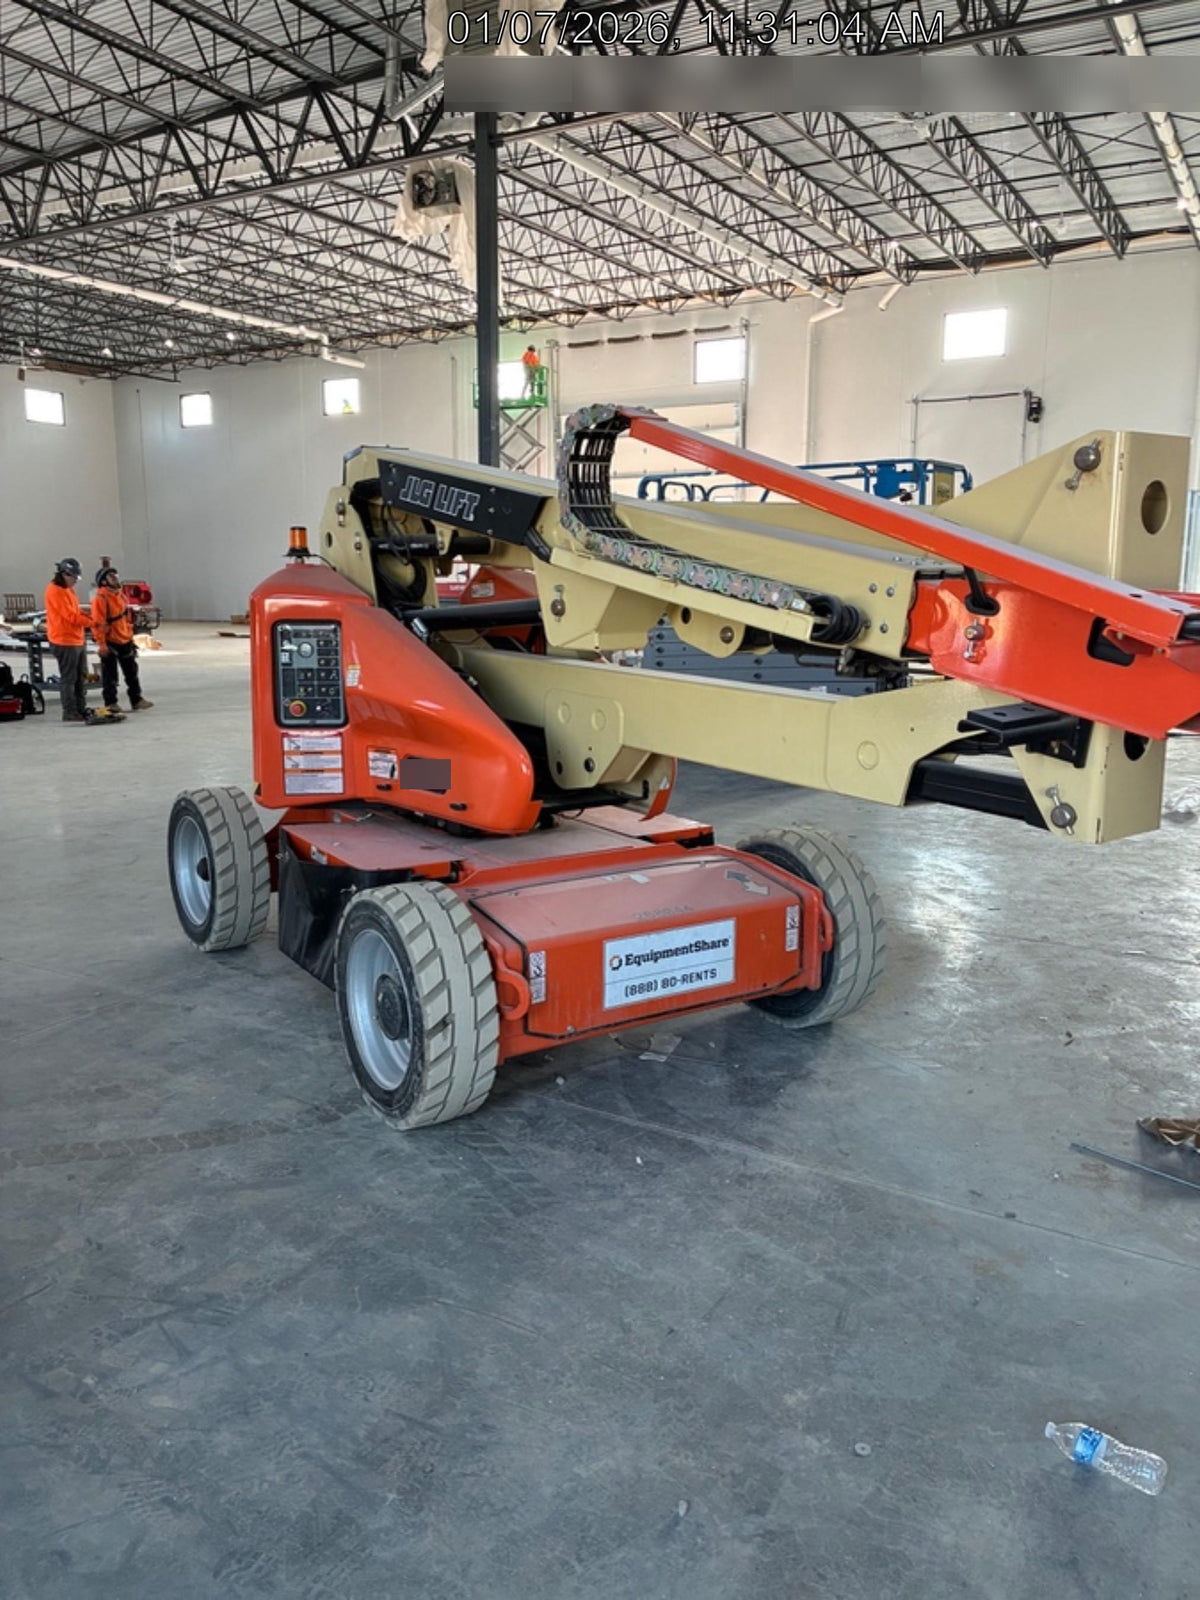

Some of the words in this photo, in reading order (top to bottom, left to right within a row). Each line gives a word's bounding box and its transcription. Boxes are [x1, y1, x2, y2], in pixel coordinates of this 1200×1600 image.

[399, 475, 436, 509] JLG
[433, 483, 481, 521] LIFT
[624, 937, 731, 966] EquipmentShare
[624, 979, 659, 998] (888)
[661, 968, 717, 989] 80-RENTS
